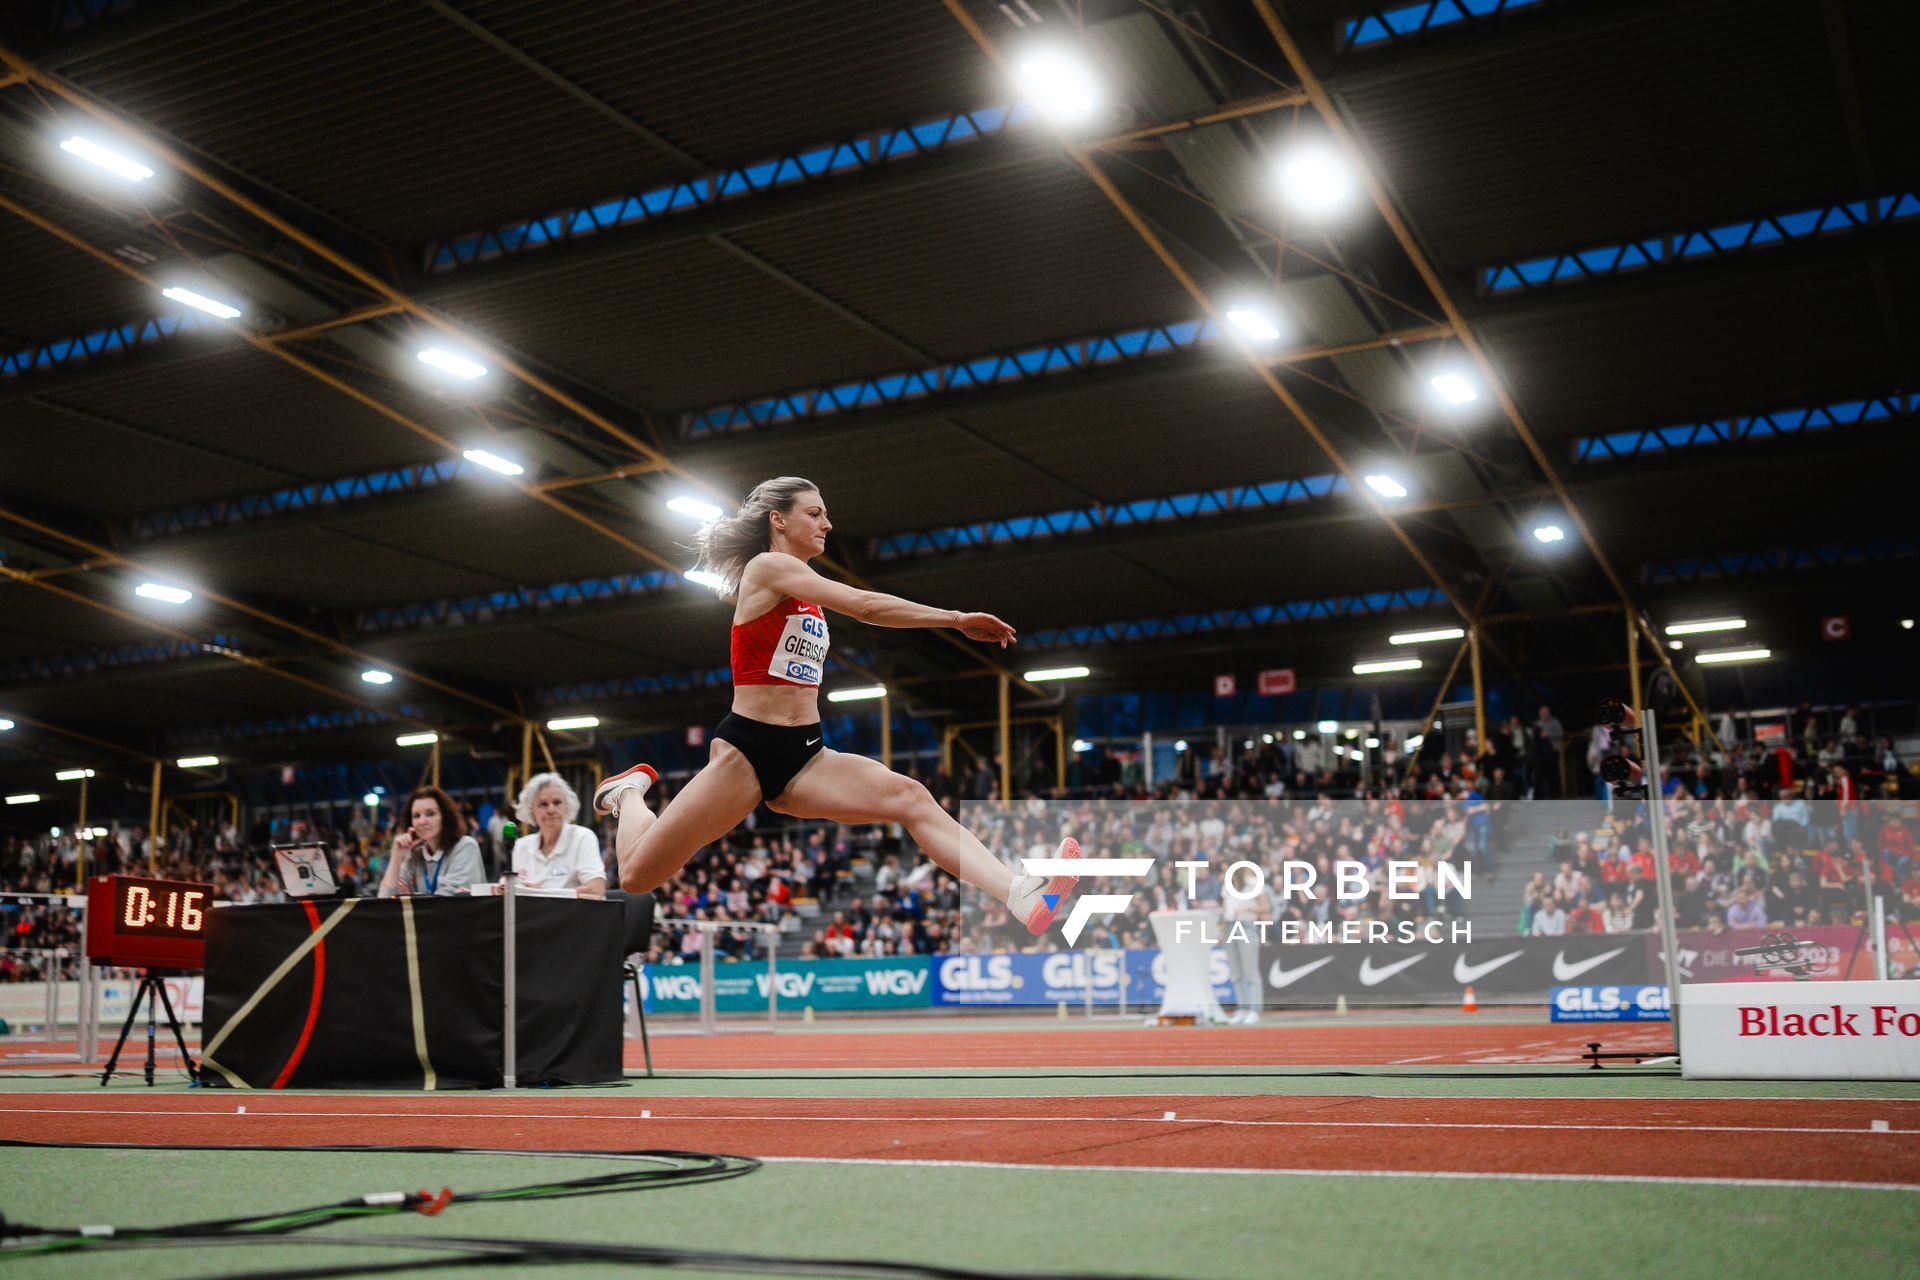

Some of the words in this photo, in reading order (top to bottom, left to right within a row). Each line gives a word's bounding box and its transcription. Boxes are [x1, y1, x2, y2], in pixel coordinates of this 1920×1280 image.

[802, 616, 823, 638] GLS
[125, 886, 204, 931] 0:16
[755, 972, 814, 997] WGV
[865, 969, 928, 995] WGV
[1738, 1005, 1860, 1037] Black
[1872, 1005, 1920, 1037] Fo
